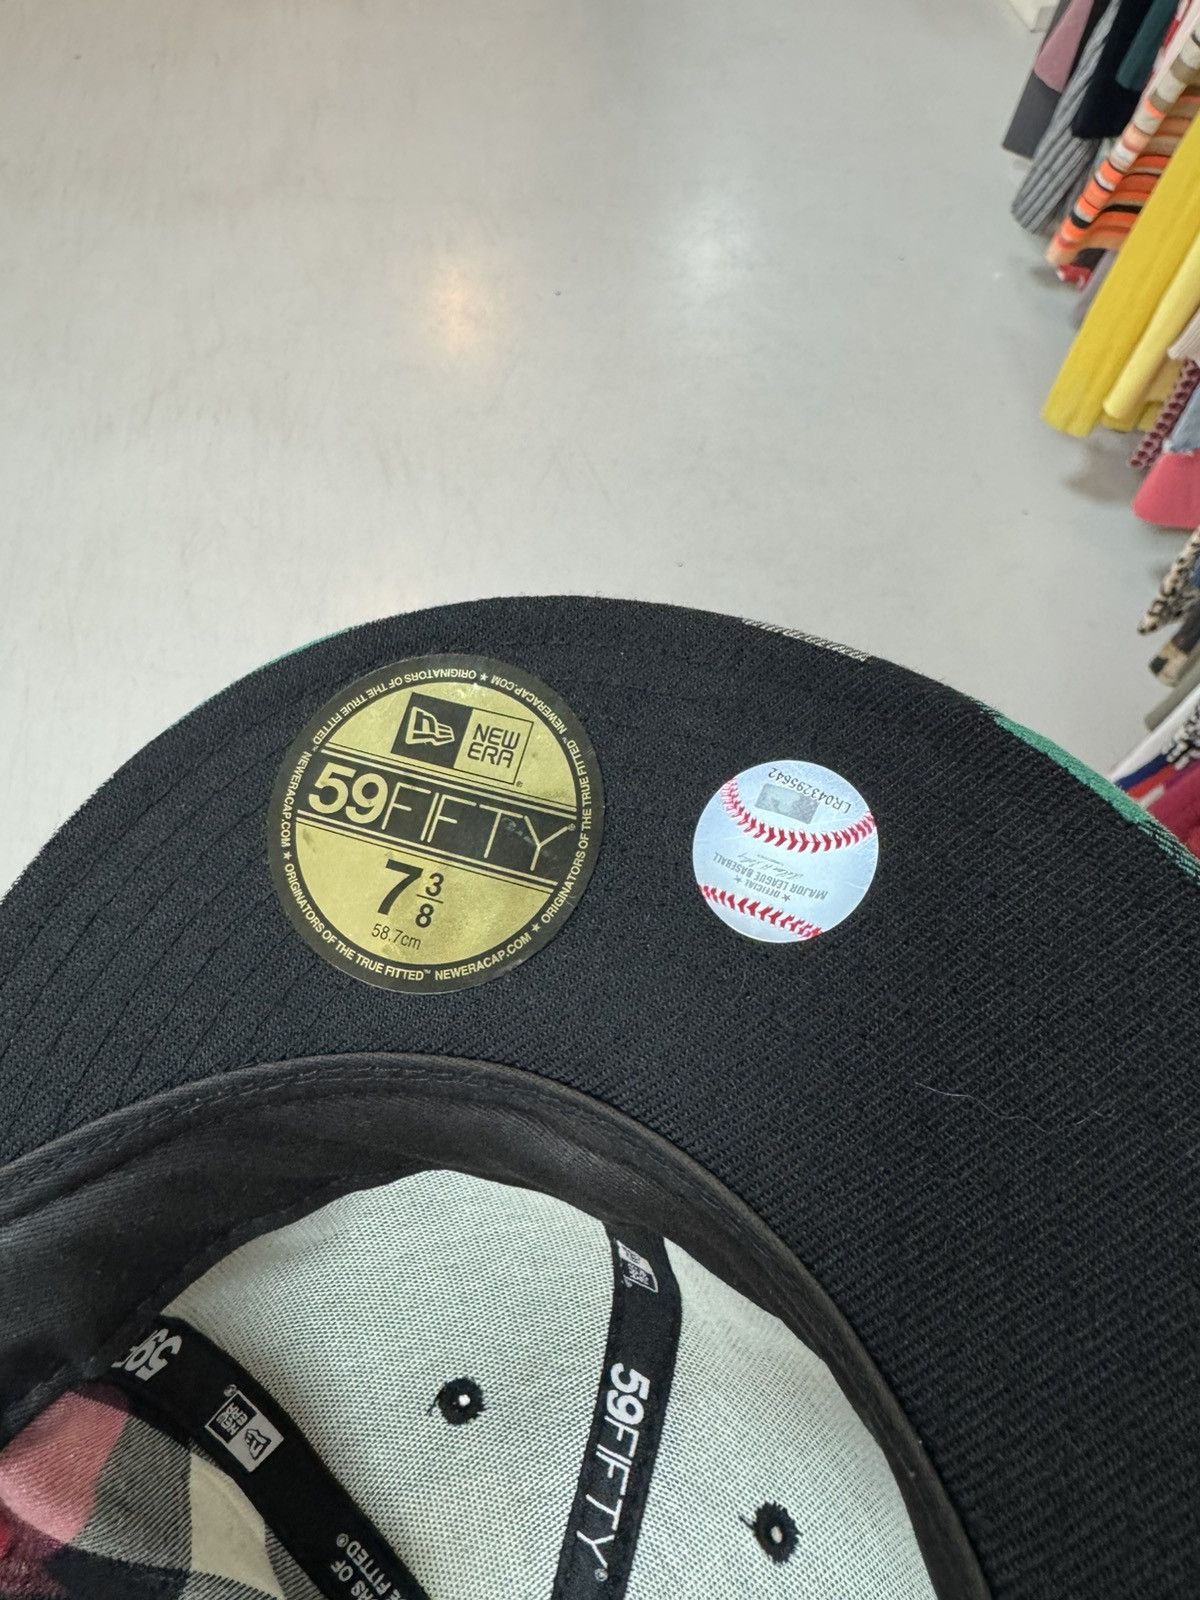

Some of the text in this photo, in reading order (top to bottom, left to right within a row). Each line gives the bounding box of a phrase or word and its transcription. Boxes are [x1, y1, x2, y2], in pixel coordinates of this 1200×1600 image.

[388, 677, 403, 689] OF
[404, 668, 477, 683] ORIGINATORS
[366, 682, 388, 699] THE
[340, 694, 367, 717] TRUE
[490, 674, 568, 735] NEWERACAP.COM
[472, 723, 521, 750] NEW
[467, 742, 514, 768] ERA
[280, 751, 313, 848] NEWERACAP.COM
[579, 776, 592, 807] TRUE
[581, 808, 593, 832] THE
[578, 832, 590, 850] OF
[713, 852, 754, 877] BASEBALL
[377, 858, 424, 916] 7
[541, 851, 586, 924] ORIGINATORS
[745, 879, 781, 898] OFFICIAL
[753, 871, 789, 892] LEAGUE
[789, 884, 829, 900] MAJOR
[284, 863, 326, 933] ORIGINATORS
[322, 930, 337, 945] OF
[335, 940, 357, 961] THE
[353, 953, 385, 974] TRUE
[435, 932, 533, 981] NEWERACAP.COM
[371, 923, 422, 950] 58.7cm
[330, 1560, 354, 1582] OF
